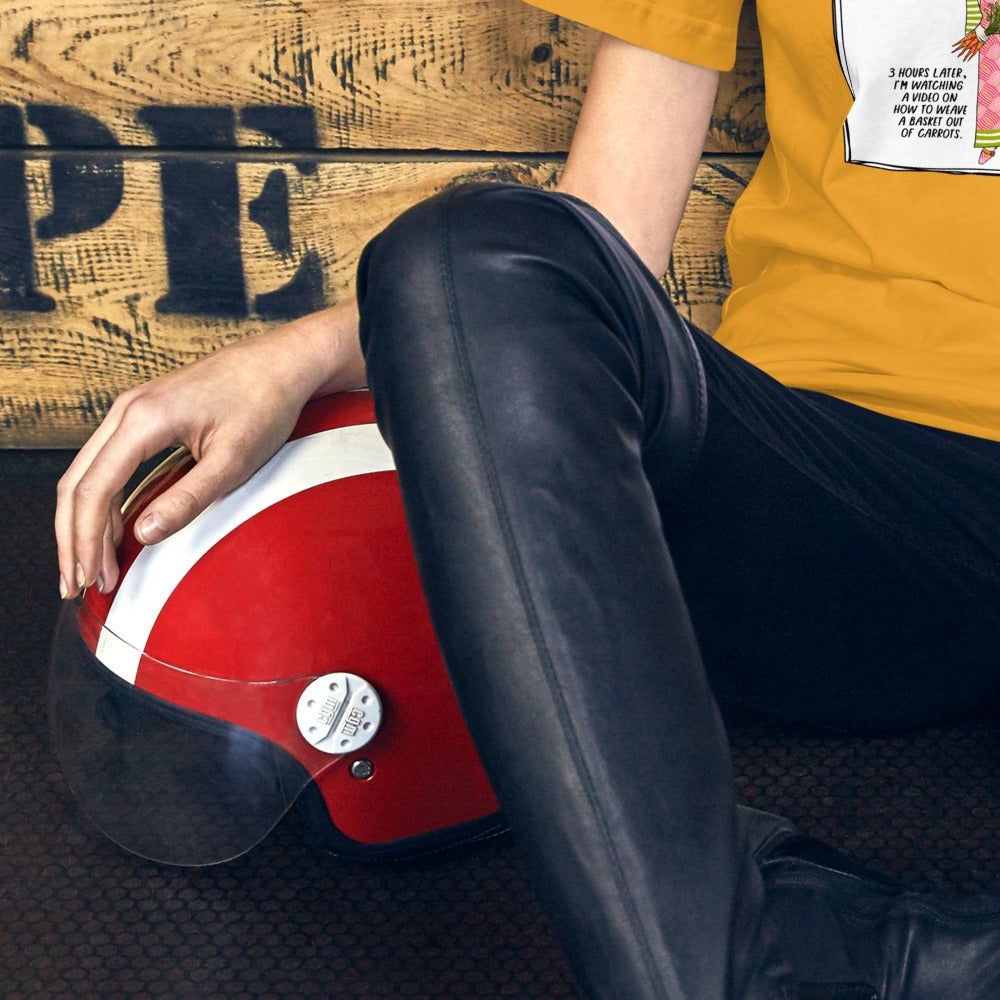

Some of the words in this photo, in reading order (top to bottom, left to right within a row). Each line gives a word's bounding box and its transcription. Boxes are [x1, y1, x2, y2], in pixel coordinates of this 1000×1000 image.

[888, 67, 896, 78] 3
[898, 67, 930, 78] HOURS
[932, 67, 967, 79] LATER,
[893, 80, 908, 90] I'M
[911, 80, 964, 91] WATCHING
[901, 92, 910, 102] A
[912, 92, 940, 102] VIDEO
[942, 92, 958, 102] ON
[893, 104, 918, 114] HOW
[921, 104, 933, 115] TO
[936, 104, 968, 115] WEAVE
[898, 116, 906, 126] A
[909, 116, 943, 126] BASKET
[946, 117, 964, 127] OUT
[901, 128, 914, 138] OF
[917, 128, 963, 139] CARROTS.
